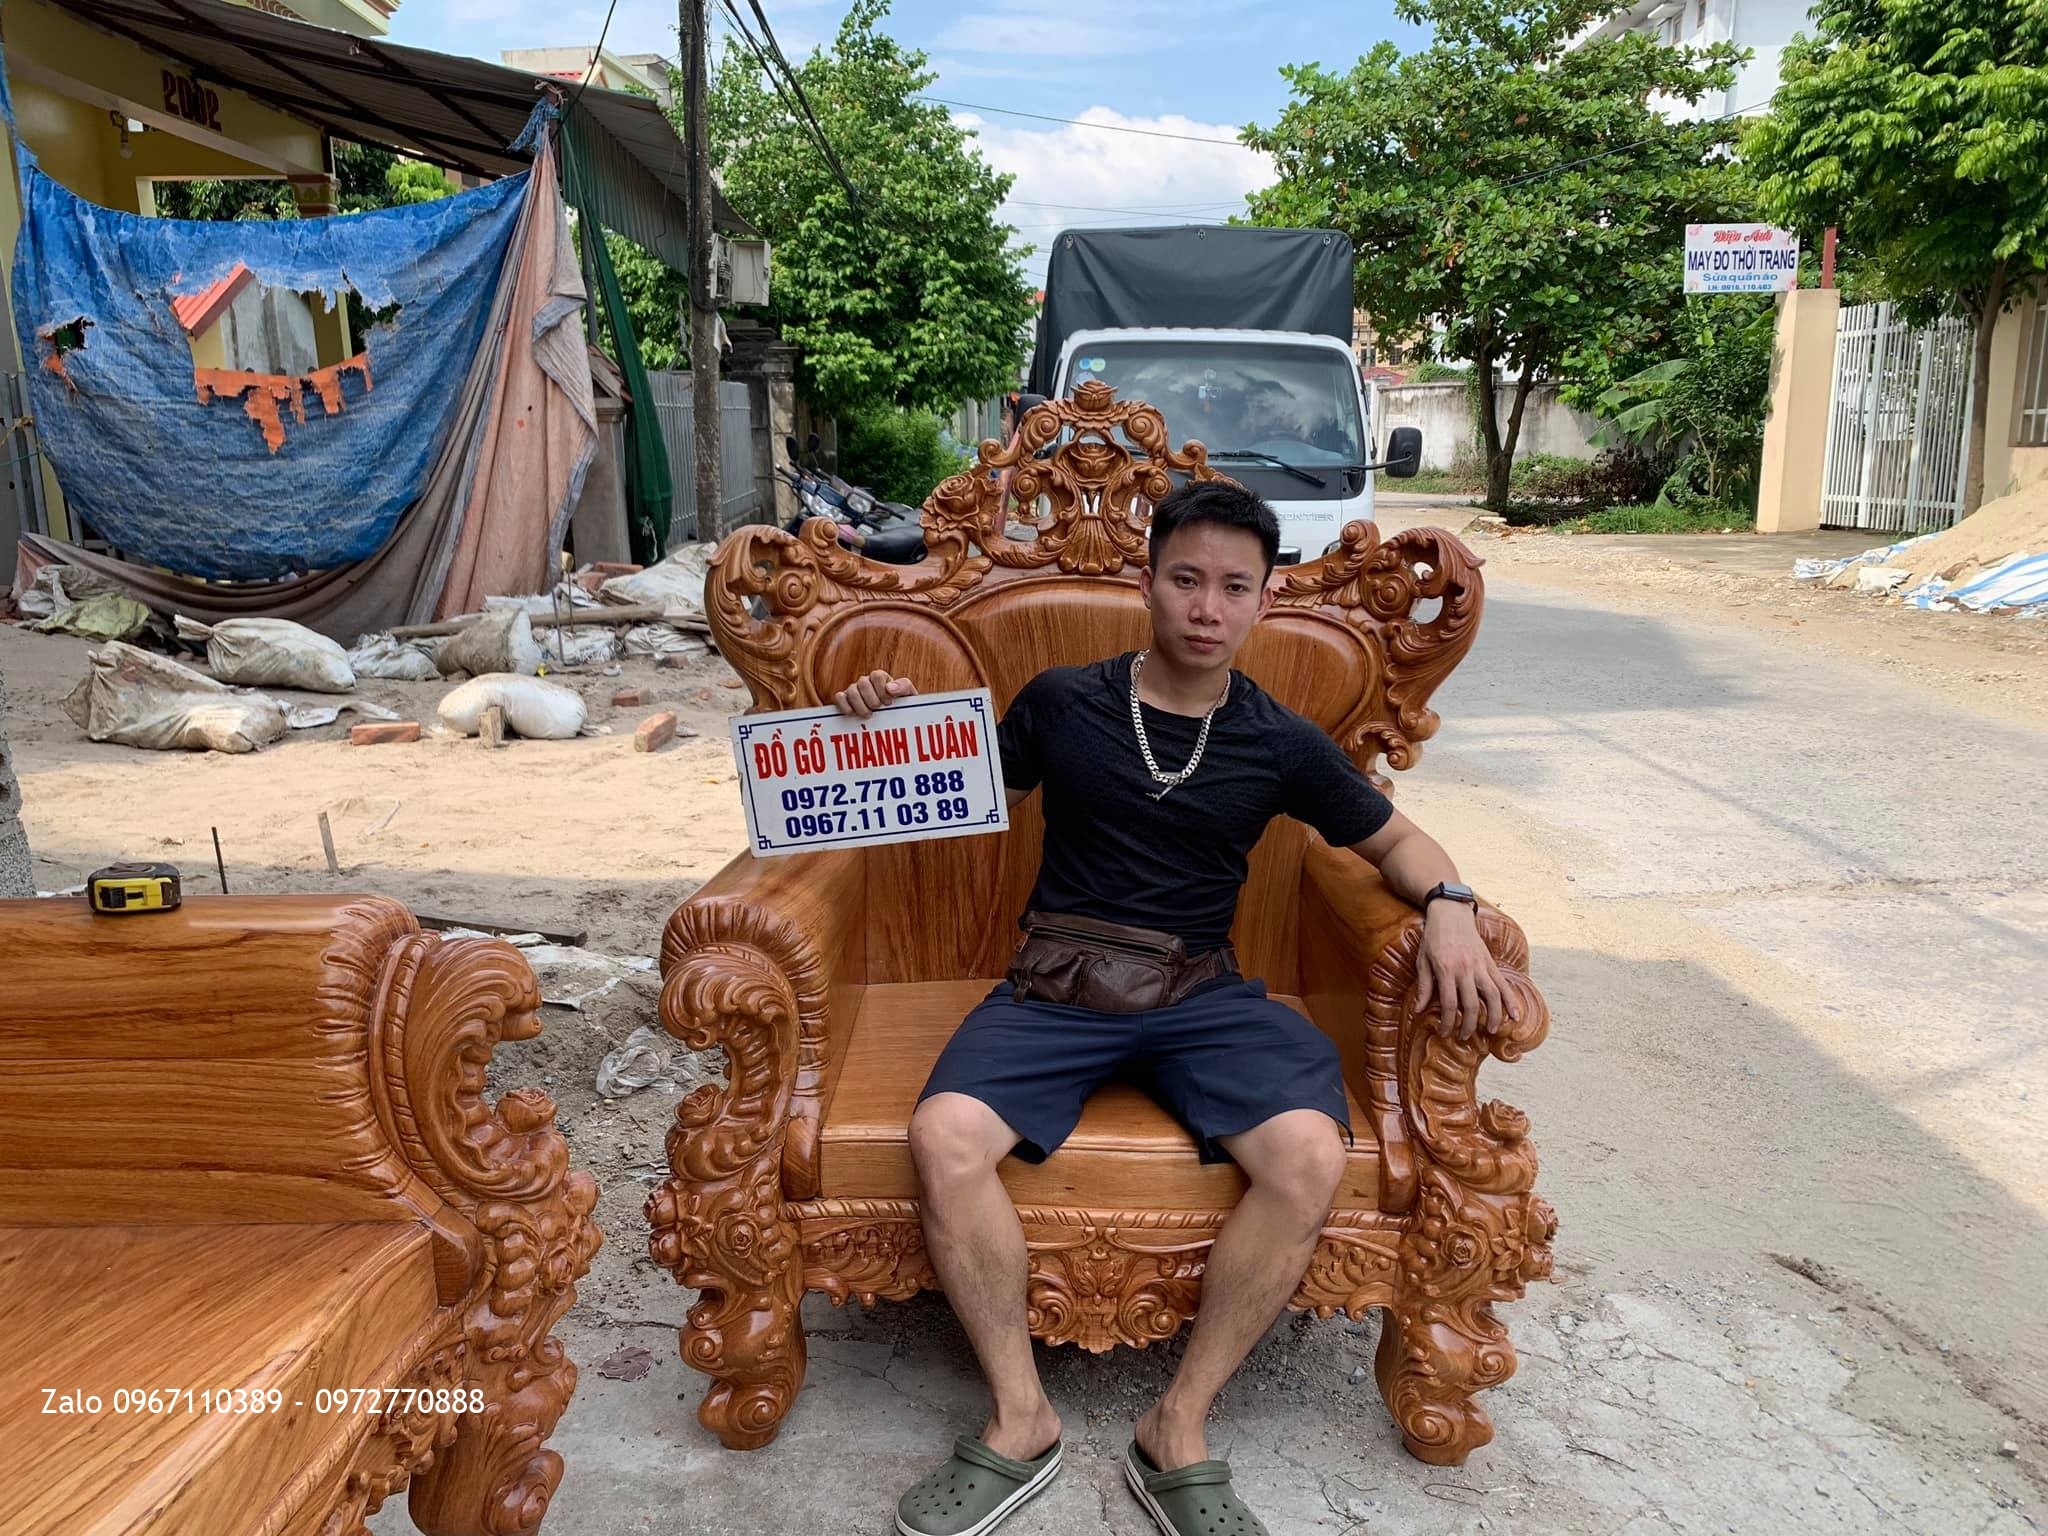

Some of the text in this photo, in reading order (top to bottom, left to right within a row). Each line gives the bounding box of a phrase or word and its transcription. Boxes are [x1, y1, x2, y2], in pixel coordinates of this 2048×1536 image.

[1688, 245, 1795, 271] MAY ĐO THỜI TRANG
[1703, 271, 1728, 282] Sửa
[1762, 271, 1778, 281] áo
[754, 715, 979, 780] ĐỒ GỖ THÀNH LUÂN
[781, 769, 965, 812] 0972.770 888
[785, 796, 969, 839] 0967.11 03 89
